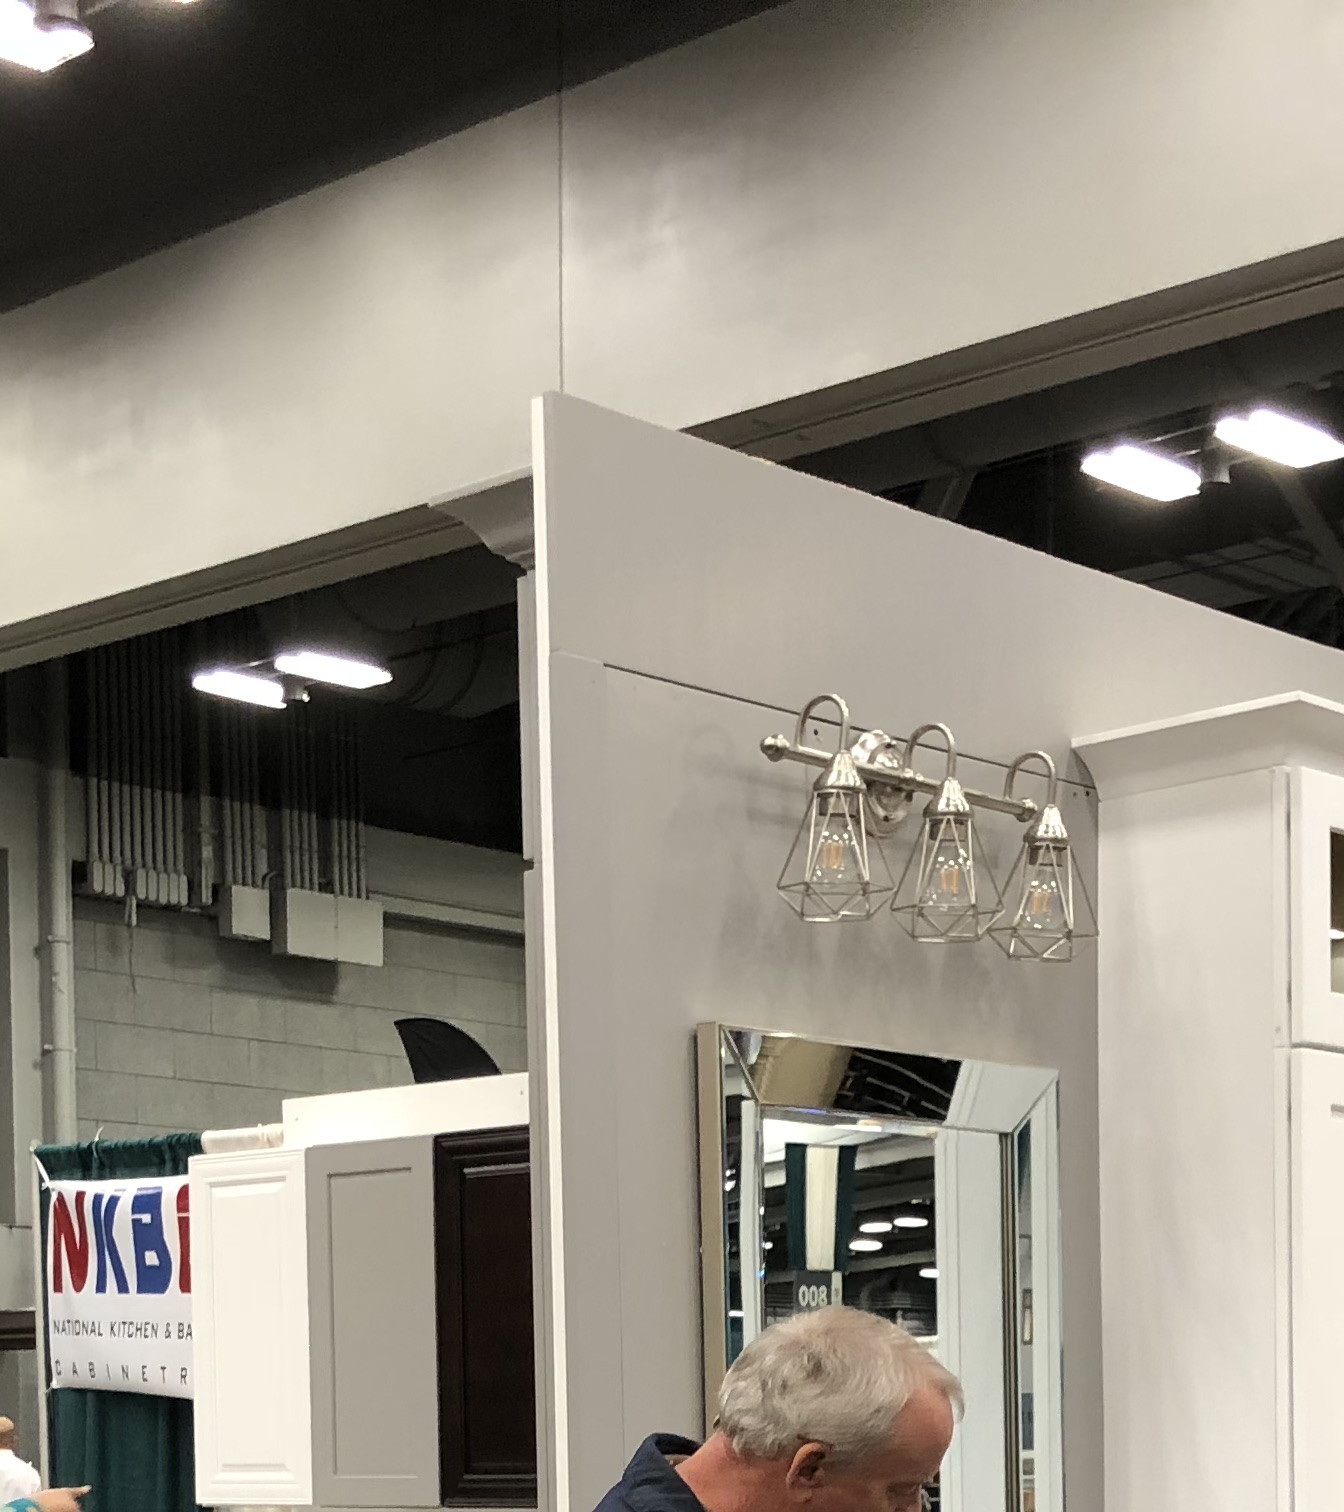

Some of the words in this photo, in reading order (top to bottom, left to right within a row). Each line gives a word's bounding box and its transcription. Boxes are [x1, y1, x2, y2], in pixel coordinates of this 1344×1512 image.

[53, 1319, 104, 1337] NATIONAL
[109, 1320, 159, 1340] KITCHEN
[164, 1322, 172, 1340] &
